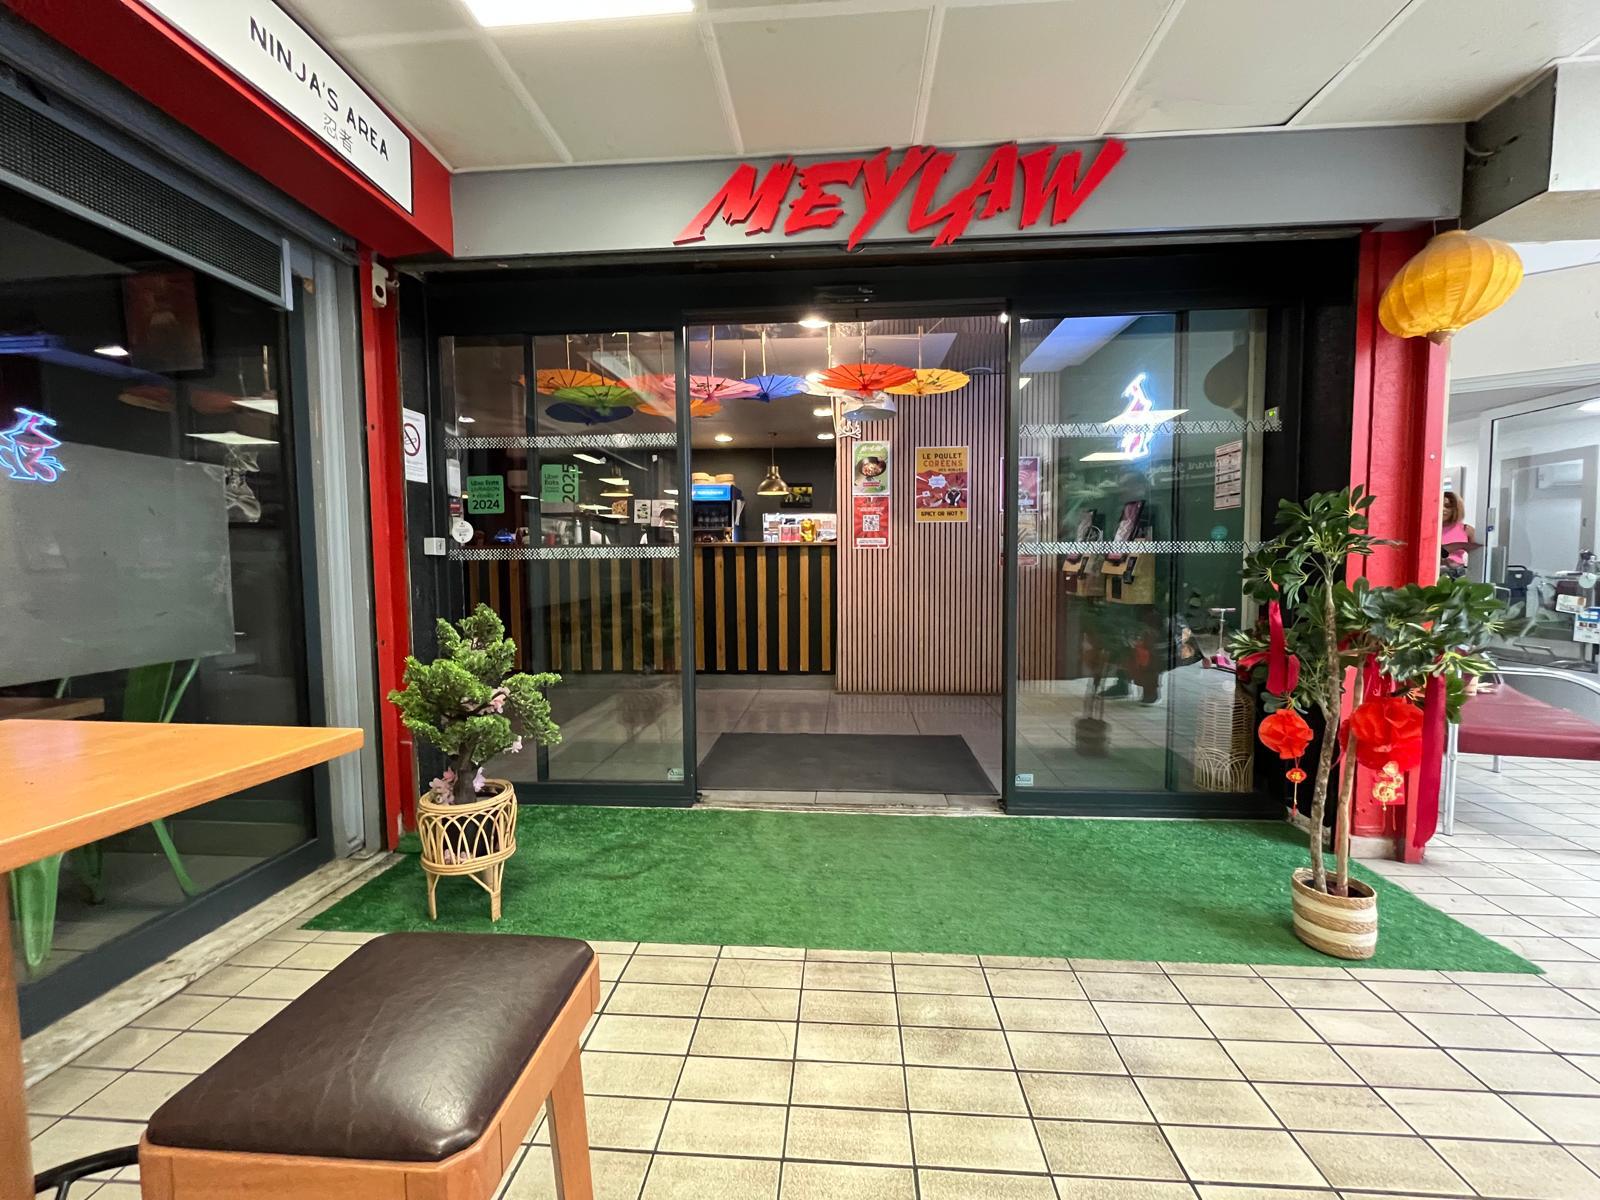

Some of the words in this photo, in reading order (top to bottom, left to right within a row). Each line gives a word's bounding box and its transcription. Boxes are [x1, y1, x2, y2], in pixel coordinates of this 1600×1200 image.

[250, 15, 339, 112] NINJA'S
[346, 106, 389, 161] AREA
[323, 112, 353, 153] 忍者
[673, 137, 1126, 251] MEYLAW
[562, 464, 576, 503] 2025
[472, 500, 500, 510] 2024
